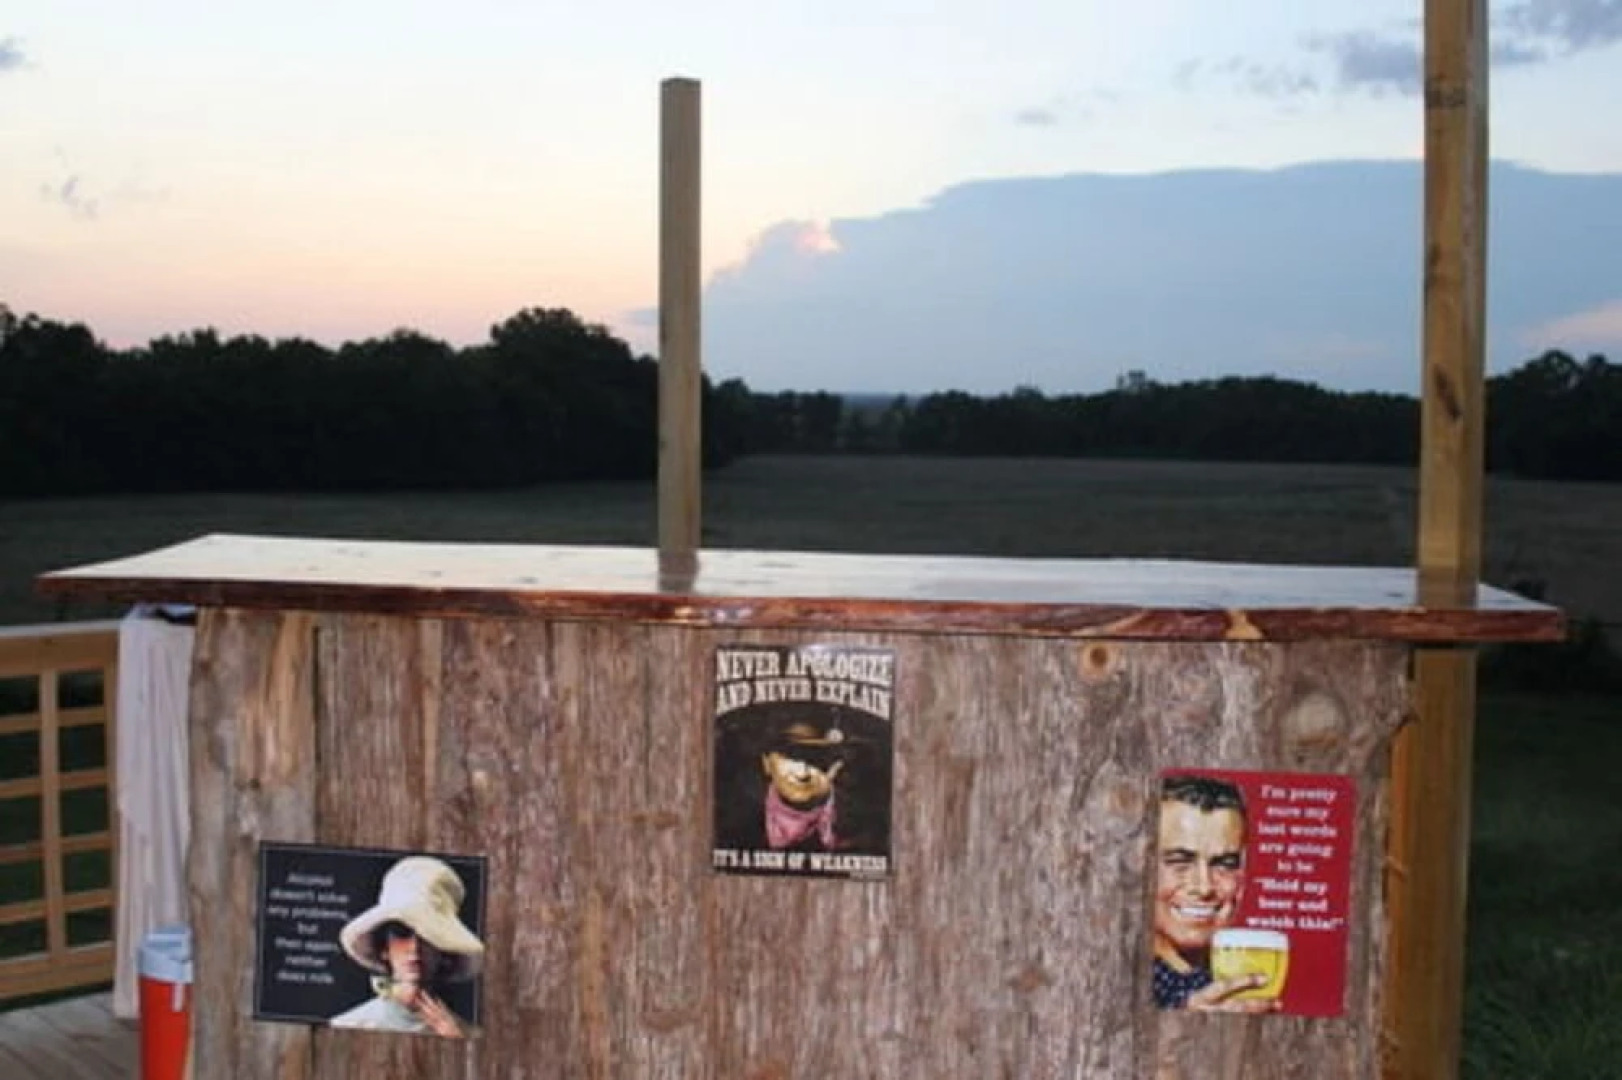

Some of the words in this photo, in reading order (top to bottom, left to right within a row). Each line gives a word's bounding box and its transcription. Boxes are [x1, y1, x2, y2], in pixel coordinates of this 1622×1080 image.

[717, 650, 780, 681] NEVER
[785, 650, 892, 686] APOLOGIZE
[717, 682, 752, 715] AND
[753, 679, 811, 704] NEVER
[816, 681, 890, 720] EXPLAIN
[1261, 785, 1285, 798] I'm
[1290, 788, 1338, 804] pretty
[1267, 807, 1301, 817] sure
[1304, 808, 1328, 820] my
[1258, 821, 1285, 834] last
[1290, 824, 1337, 837] words
[1258, 843, 1284, 853] are
[1287, 844, 1332, 857] going
[1277, 860, 1292, 871] to
[1296, 860, 1314, 872] be
[1303, 882, 1328, 895] my
[1258, 895, 1292, 909] beer
[1298, 898, 1328, 911] and
[1246, 916, 1295, 928] watch
